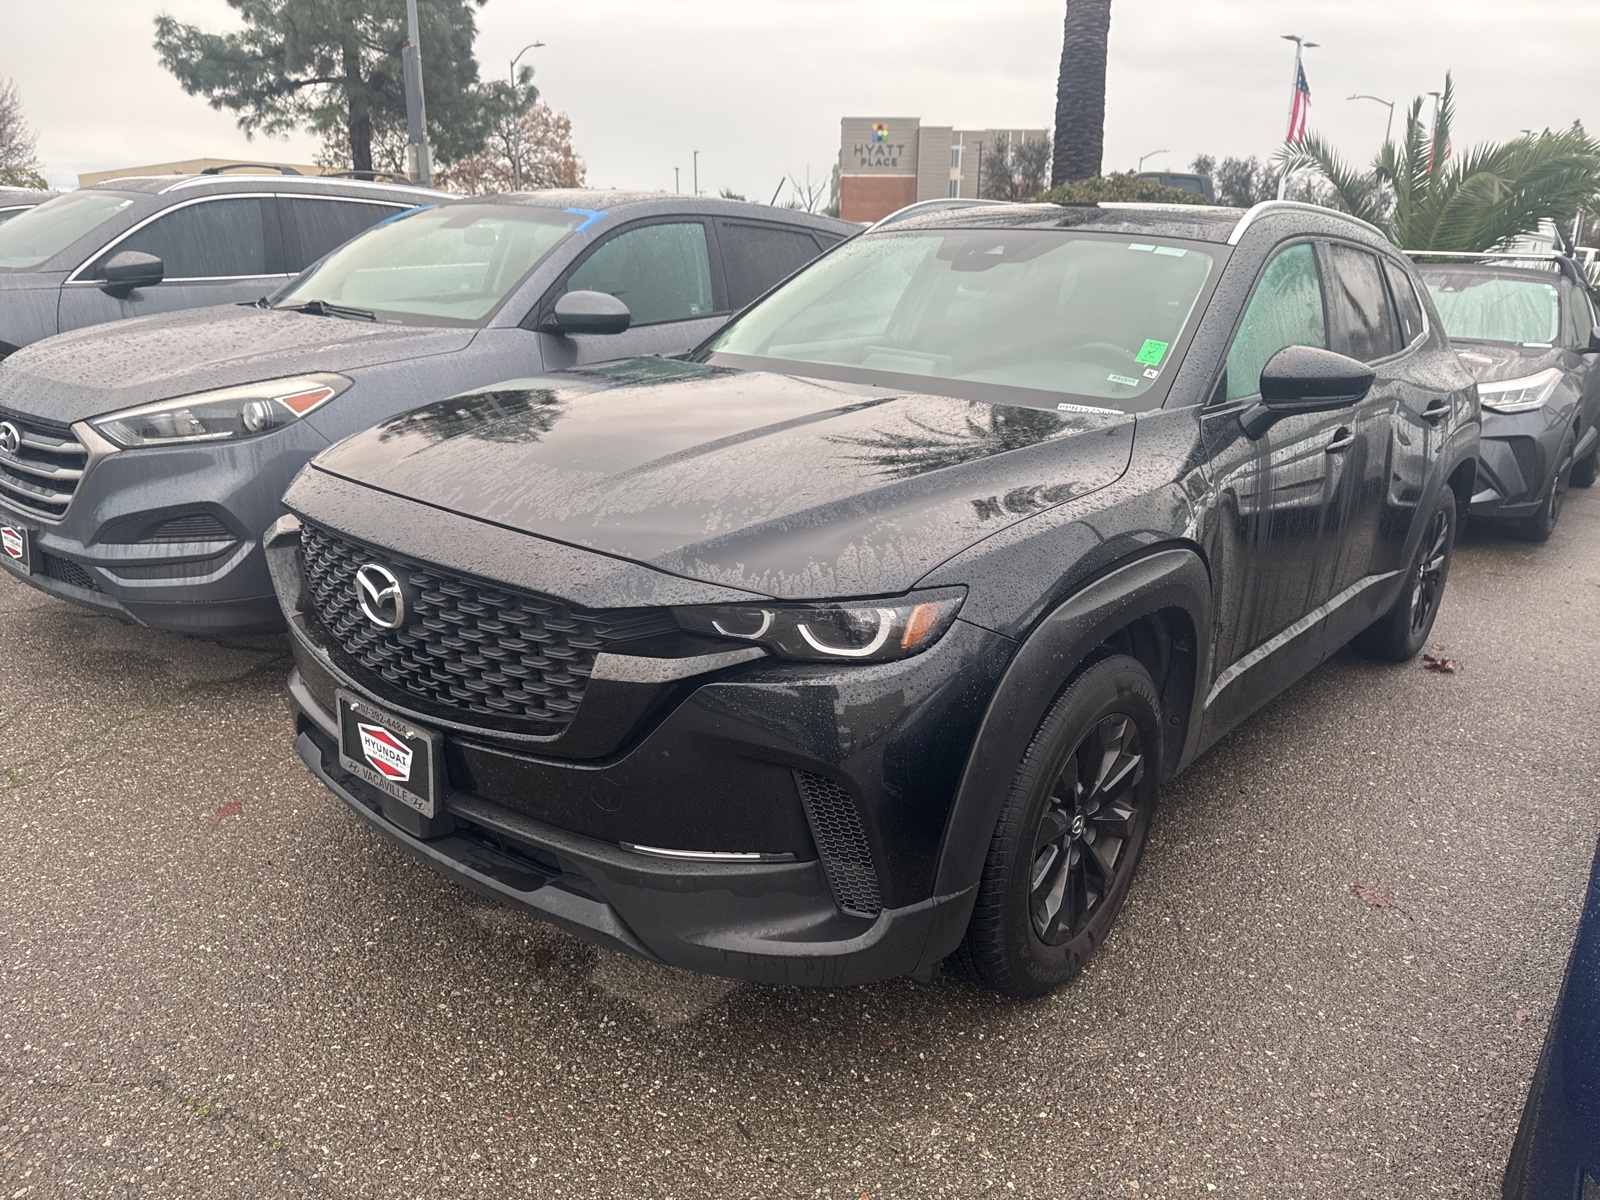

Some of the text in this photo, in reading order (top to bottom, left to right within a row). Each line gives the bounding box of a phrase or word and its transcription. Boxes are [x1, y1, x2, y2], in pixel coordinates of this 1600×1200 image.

[854, 144, 905, 156] HYATT
[861, 157, 898, 167] PLACE
[356, 702, 407, 733] 707-392-4484
[364, 736, 406, 766] HYUNDAI
[362, 767, 408, 803] VACAVILLE
